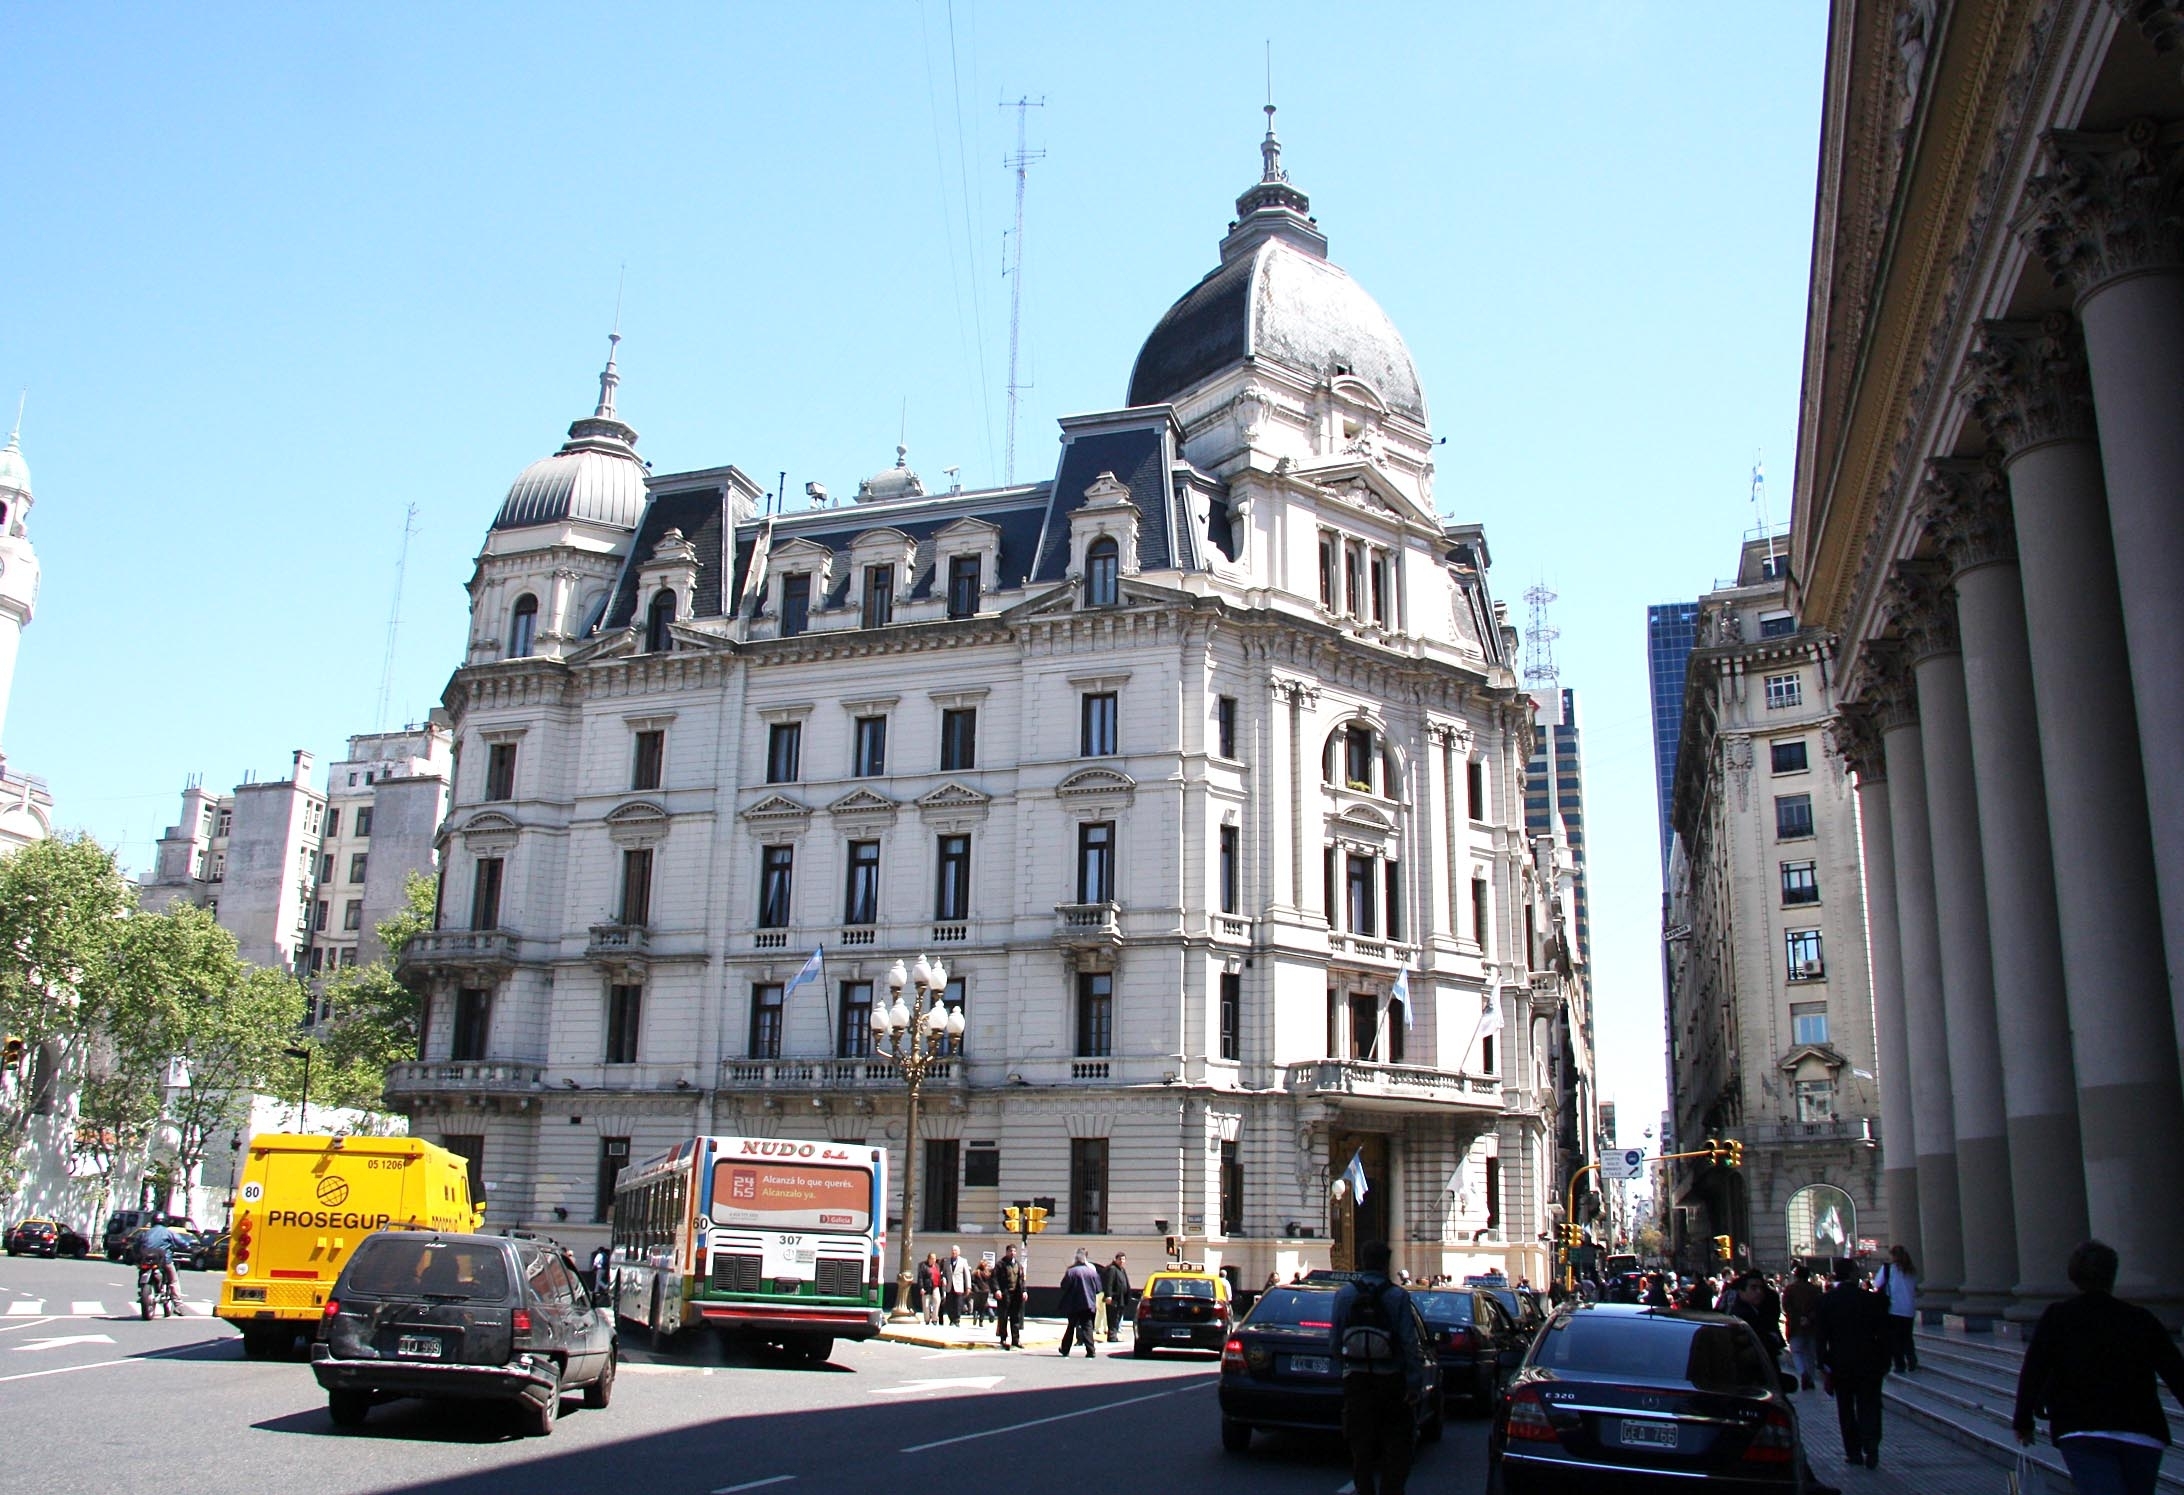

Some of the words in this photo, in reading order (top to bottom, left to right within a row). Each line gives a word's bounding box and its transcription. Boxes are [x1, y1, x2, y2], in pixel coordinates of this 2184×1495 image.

[740, 1140, 816, 1158] NUDO
[368, 1159, 379, 1169] 05
[382, 1160, 403, 1170] 1206
[734, 1176, 755, 1188] 24
[762, 1175, 796, 1186] Alcanzá
[797, 1176, 806, 1186] lo
[807, 1178, 823, 1189] que
[245, 1186, 260, 1198] 80
[762, 1188, 802, 1199] Alcanzalo
[268, 1210, 390, 1230] PROSEGUR
[693, 1217, 708, 1230] 60
[779, 1235, 803, 1246] 307
[1554, 1392, 1575, 1400] 320
[1623, 1426, 1646, 1441] GEA
